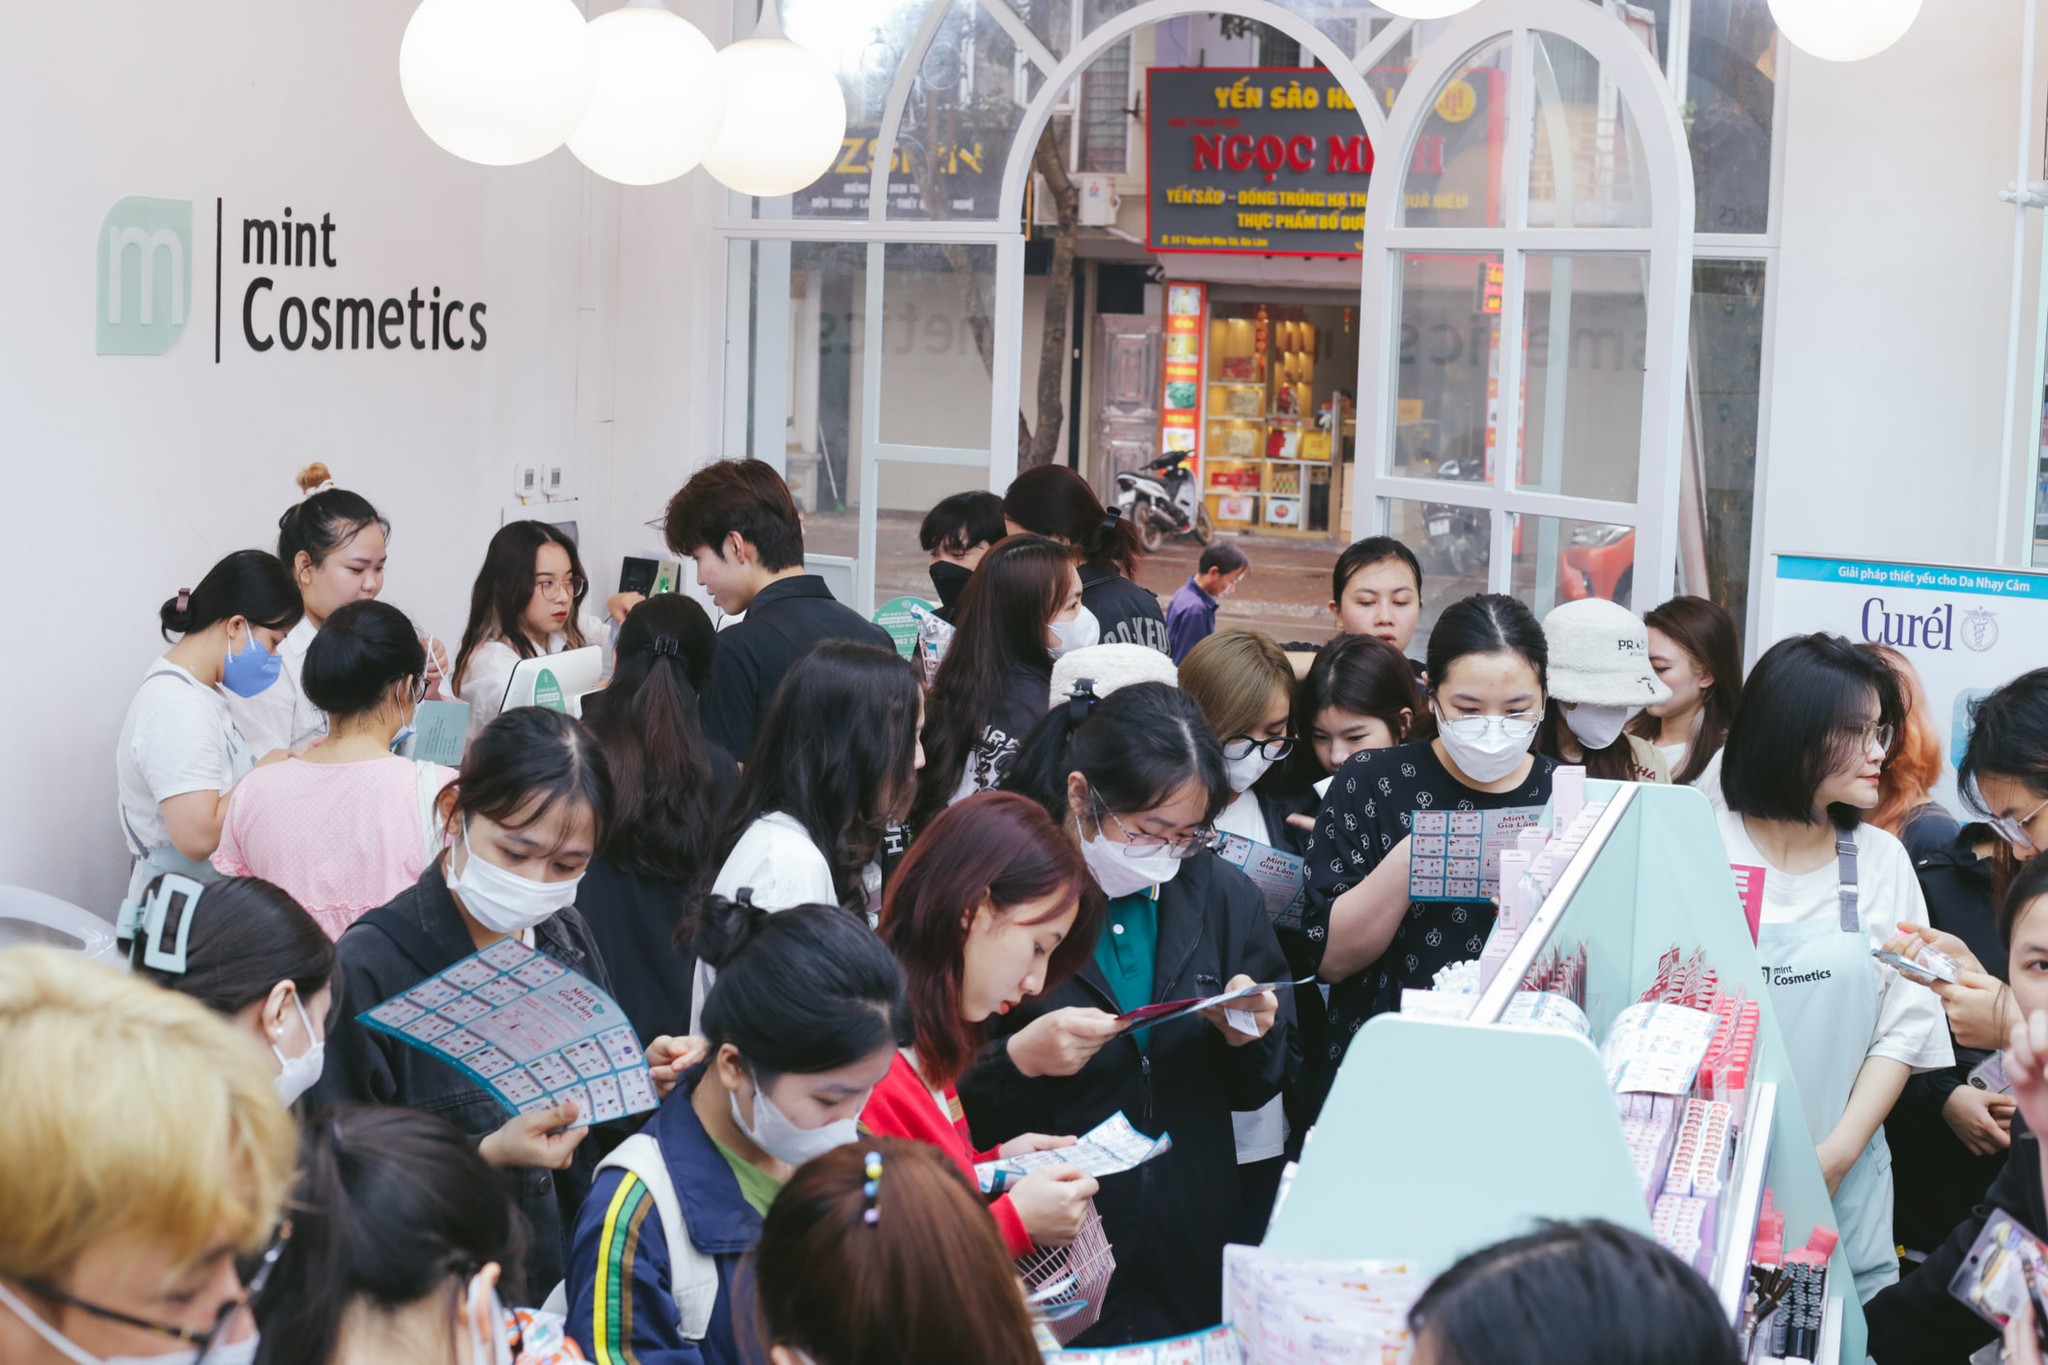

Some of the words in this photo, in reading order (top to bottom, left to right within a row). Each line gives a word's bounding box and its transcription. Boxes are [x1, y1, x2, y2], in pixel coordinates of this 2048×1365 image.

[1215, 76, 1263, 109] YẾN
[1270, 80, 1320, 109] SÀO
[1191, 133, 1317, 182] NGỌC
[1326, 135, 1445, 174] MIH
[242, 207, 337, 267] mint
[242, 277, 487, 352] Cosmetics
[1838, 566, 1859, 578] Giải
[1860, 567, 1887, 583] pháp
[1889, 570, 1915, 583] thiết
[1916, 571, 1936, 586] yếu
[1938, 574, 1957, 587] cho
[1959, 575, 1975, 588] Da
[1976, 576, 2004, 592] Nhạy
[2006, 578, 2030, 592] Cảm
[1861, 597, 1953, 651] Curél
[1774, 965, 1793, 975] mint
[1774, 969, 1831, 986] Cosmetics
